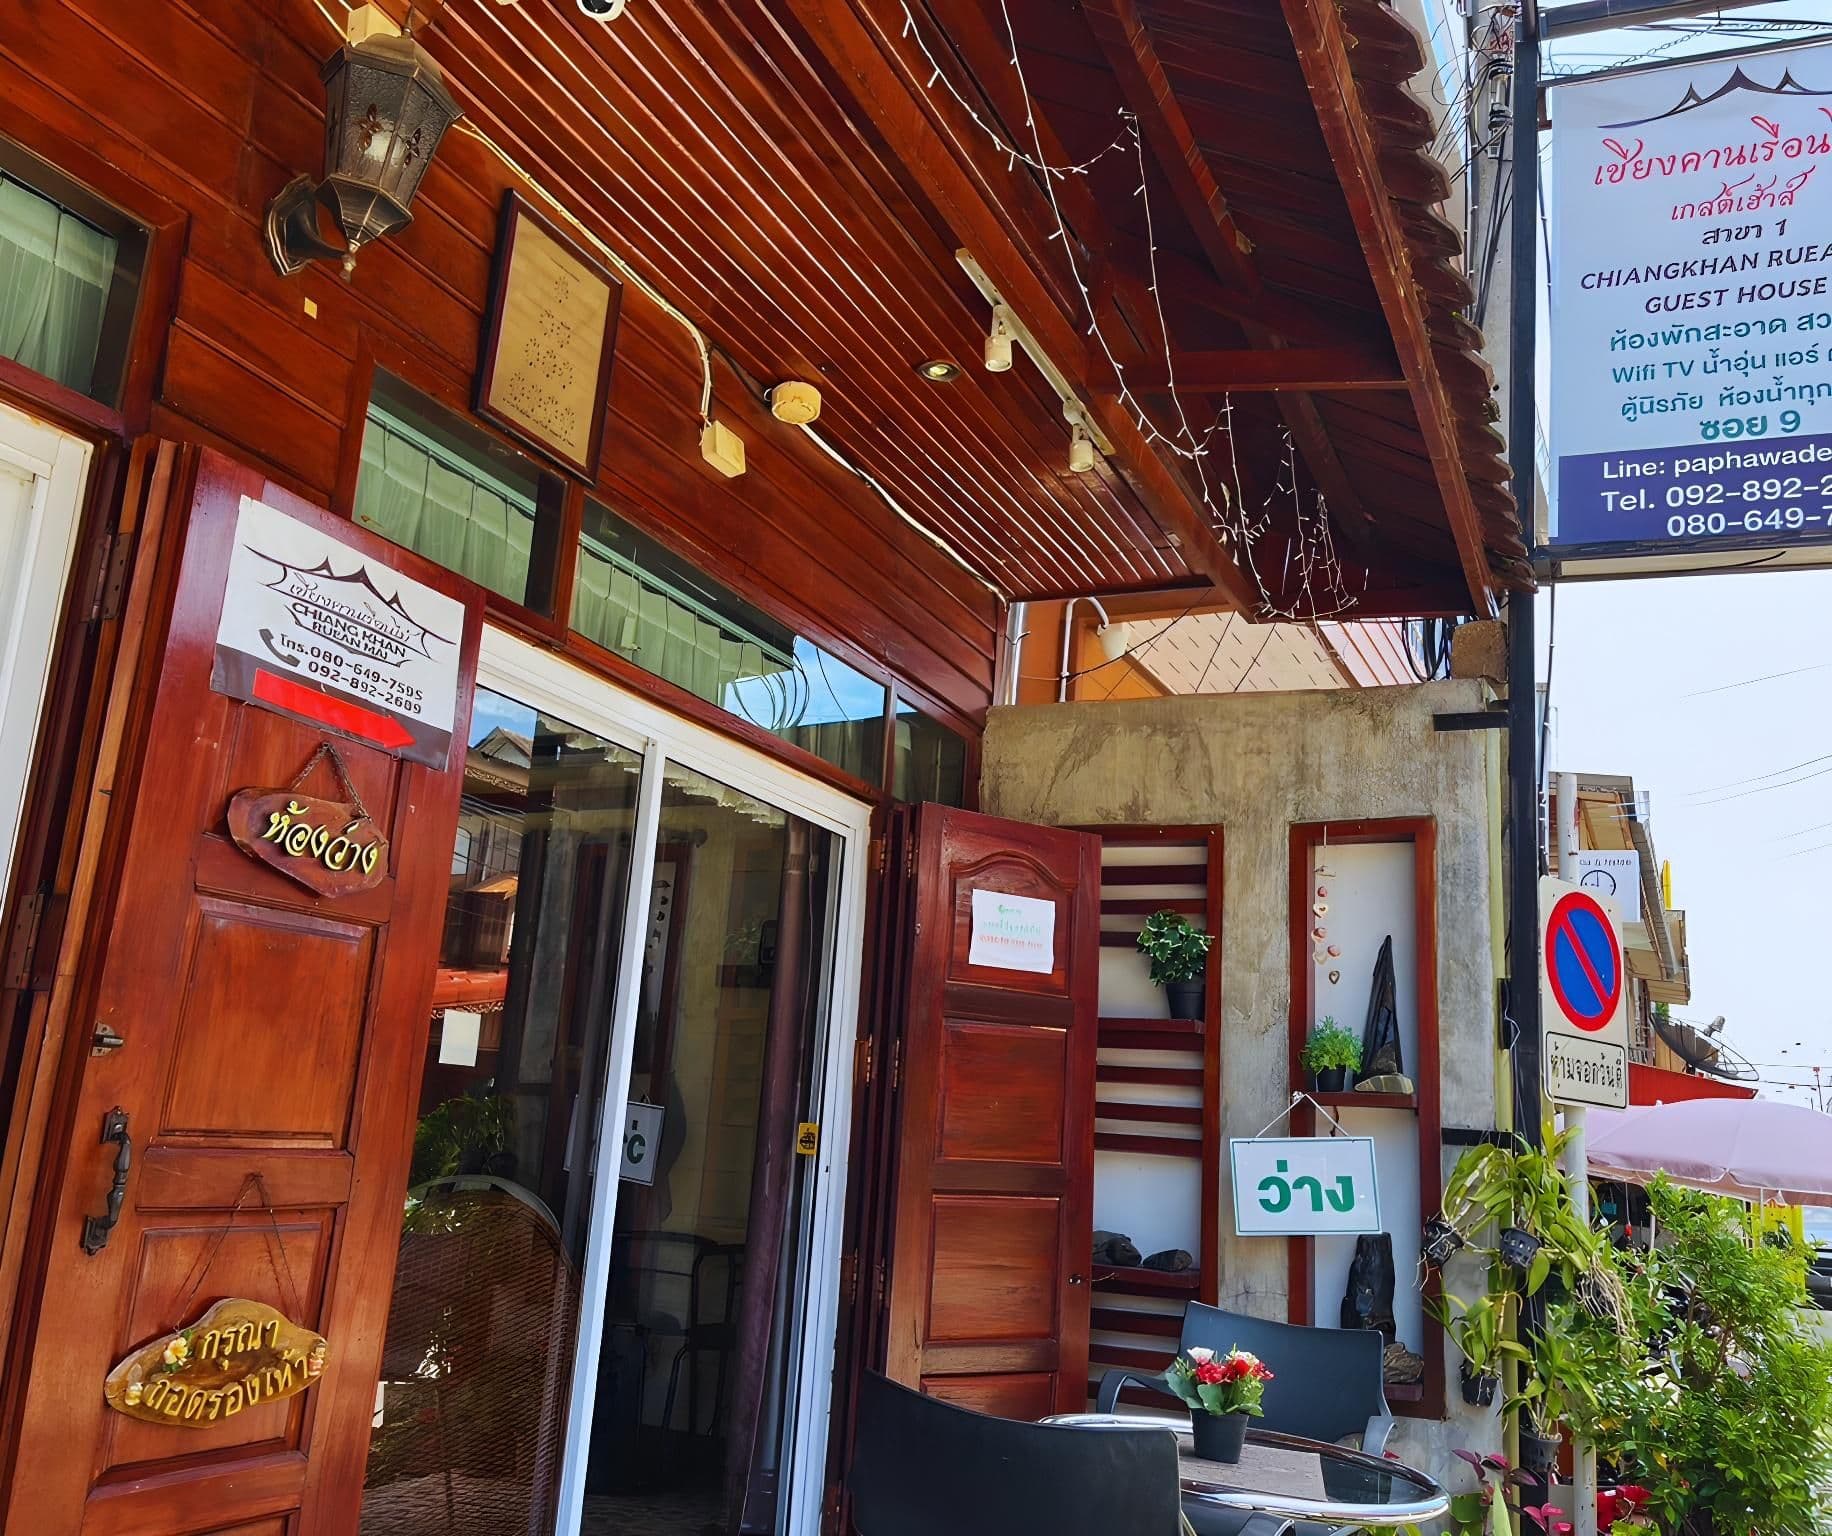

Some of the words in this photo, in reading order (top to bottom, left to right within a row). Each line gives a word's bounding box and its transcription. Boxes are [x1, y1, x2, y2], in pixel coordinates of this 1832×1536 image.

[1701, 223, 1763, 245] สาขา
[1775, 218, 1788, 236] 1
[1580, 252, 1760, 290] CHIANGKHAN
[1645, 288, 1730, 314] GUEST
[1737, 276, 1828, 304] HOUSE
[1610, 317, 1787, 351] ห้องพักสะอาด
[1611, 363, 1656, 384] Wifi
[1662, 359, 1695, 379] TV
[1702, 348, 1766, 378] น้ำอุ่น
[1775, 343, 1819, 368] แอร์
[1699, 415, 1768, 440] ซอย
[1779, 410, 1801, 433] 9
[1603, 462, 1665, 479] Line:
[1674, 443, 1832, 477] paphawade
[1601, 489, 1655, 512] Tel.
[1665, 474, 1832, 508] 092-892-2
[1667, 504, 1832, 537] 080-649-7
[291, 602, 359, 638] CHIANG
[361, 630, 406, 658] KHAN
[311, 620, 360, 649] RUEAN
[363, 643, 389, 661] MAI
[262, 800, 379, 875] ห้องว่าง
[1257, 1159, 1356, 1214] ว่าง
[201, 1319, 280, 1371] กรุณา
[145, 1348, 309, 1421] ถอดรองเท้า
